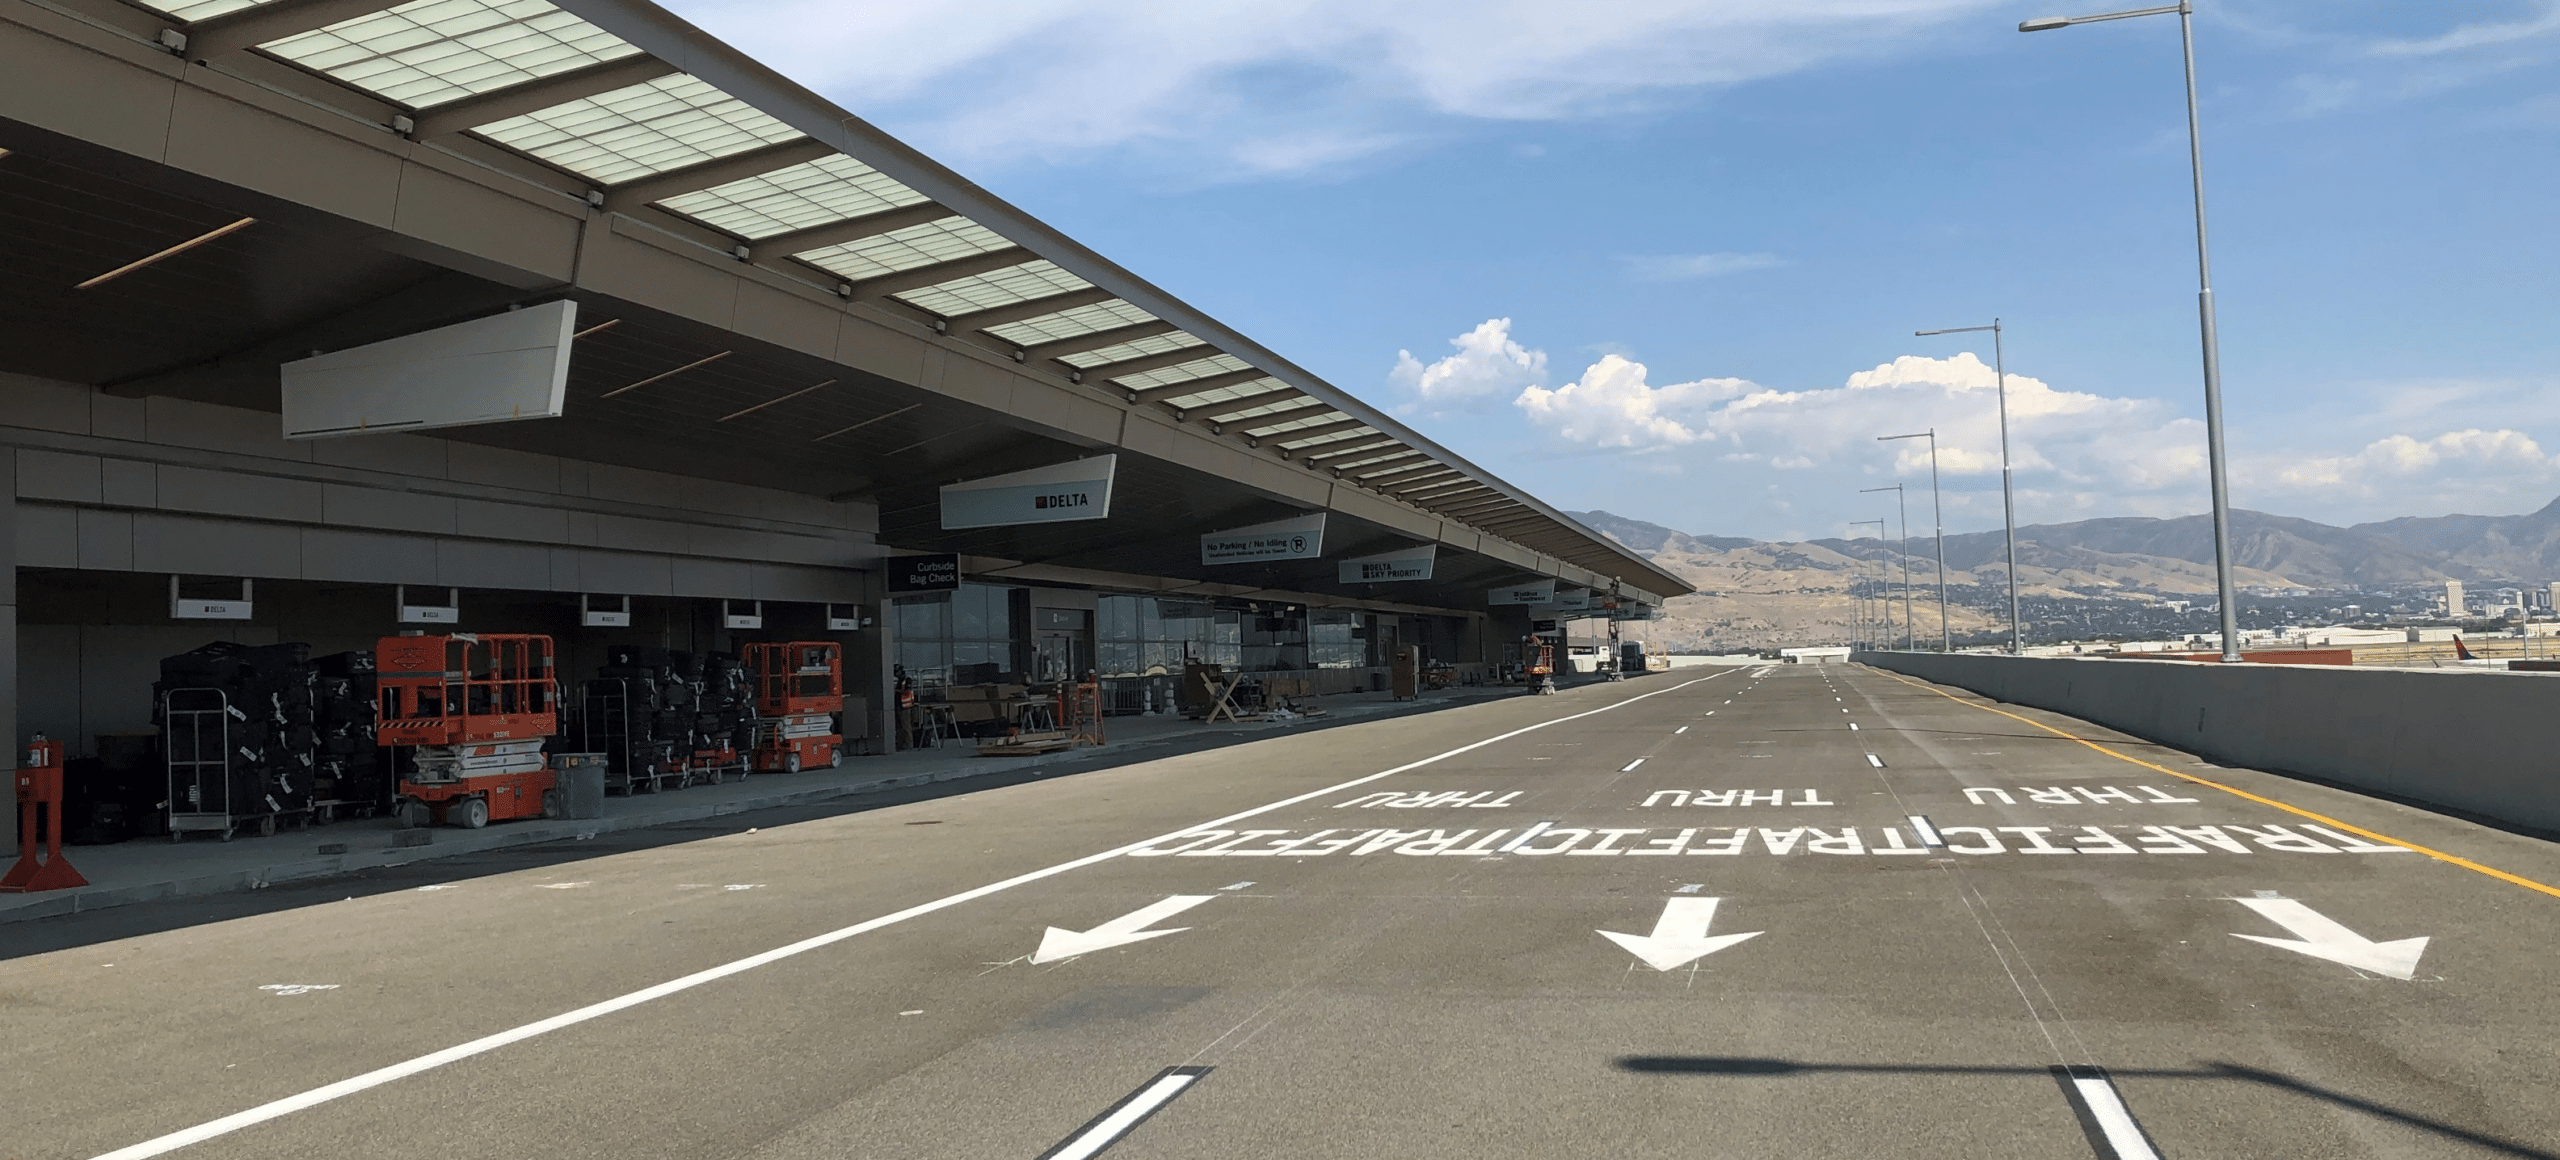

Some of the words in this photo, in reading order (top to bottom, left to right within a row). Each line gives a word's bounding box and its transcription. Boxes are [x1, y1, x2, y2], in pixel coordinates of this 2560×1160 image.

[1049, 493, 1088, 508] DELTA
[1206, 543, 1218, 551] No
[1219, 541, 1247, 550] Parking
[1254, 540, 1264, 548] No
[1266, 539, 1287, 547] Idling
[917, 561, 955, 572] Curbside
[1369, 563, 1392, 571] DELTA
[1370, 571, 1385, 579] SKY
[1388, 569, 1421, 578] PRIORITY
[910, 574, 927, 586] Bag
[928, 572, 956, 583] Check
[210, 605, 226, 613] DELTA
[1333, 791, 1524, 808] THRU
[1642, 789, 1833, 807] THRU
[1962, 785, 2200, 805] THRU
[1127, 828, 1511, 857] TRAFFIC
[1511, 827, 1930, 857] TRAFFIC
[1940, 823, 2413, 855] TRAFFIC
